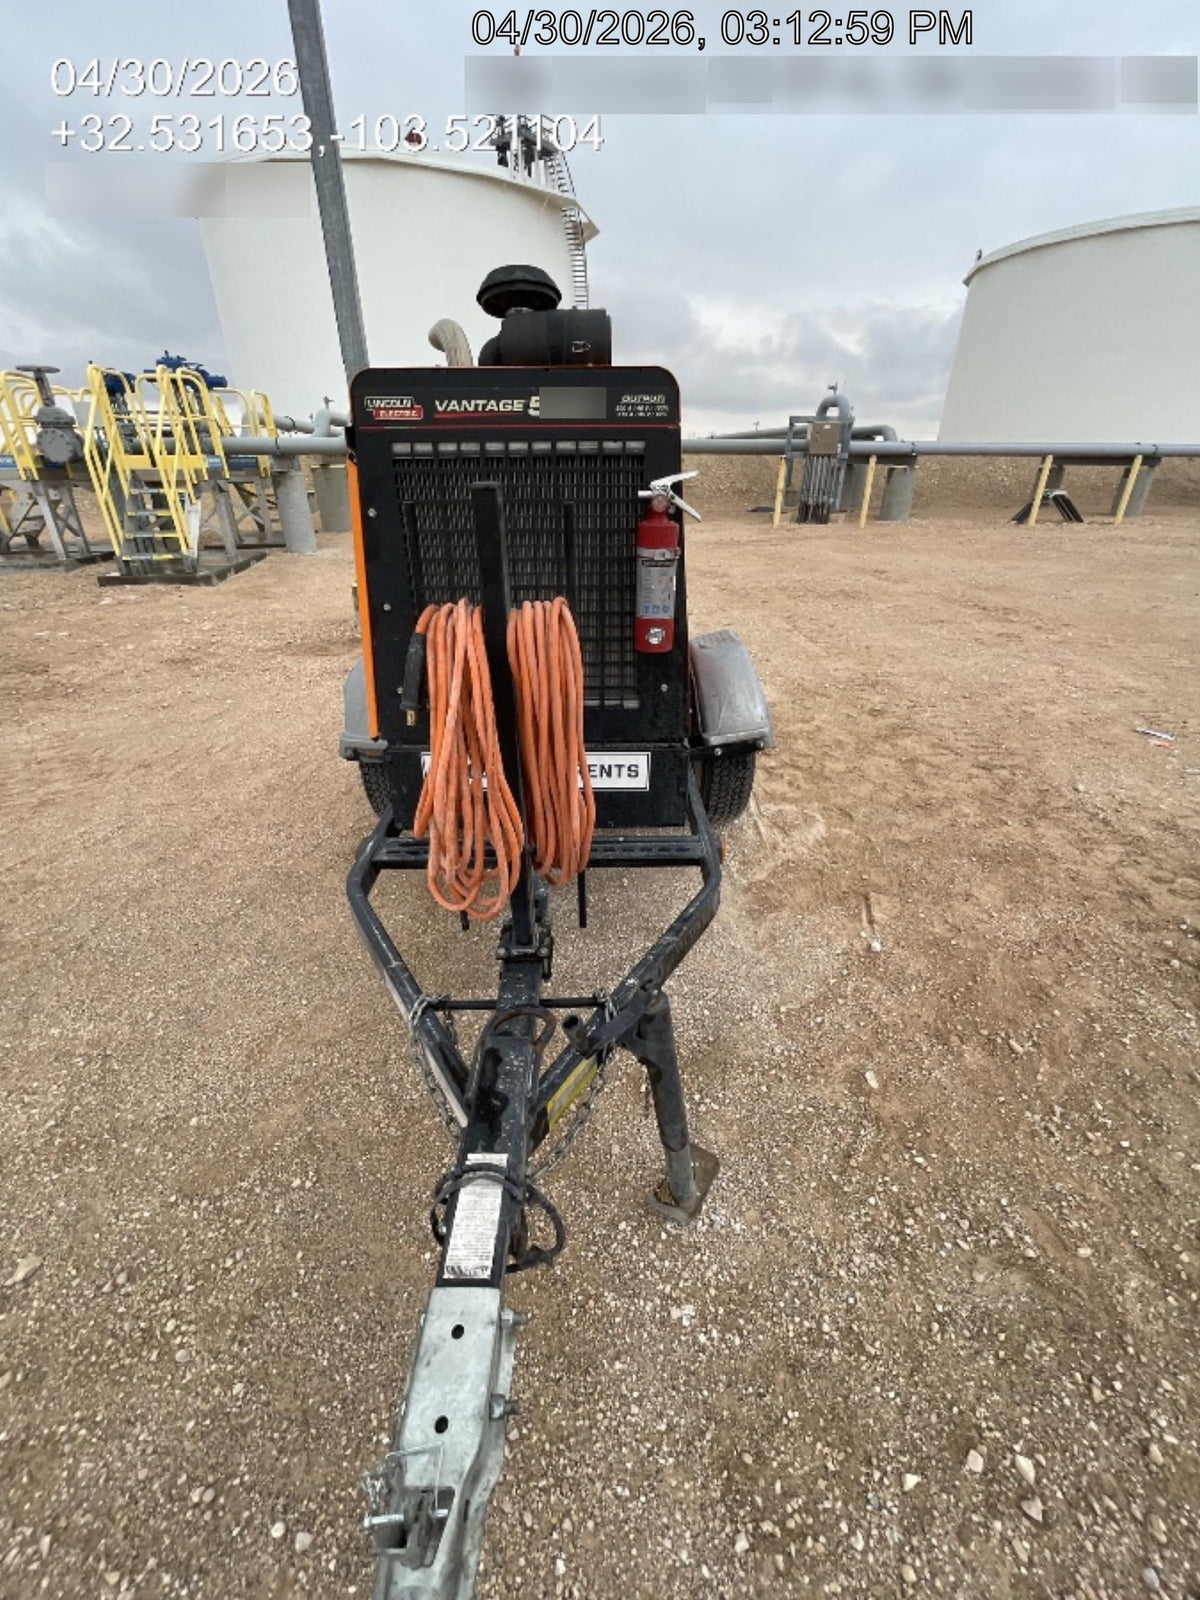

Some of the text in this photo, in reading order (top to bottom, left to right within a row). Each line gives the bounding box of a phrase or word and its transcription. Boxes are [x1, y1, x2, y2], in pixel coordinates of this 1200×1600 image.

[367, 399, 411, 408] LINCOLN
[434, 399, 525, 412] VANTAGE
[579, 763, 640, 779] ENTS
